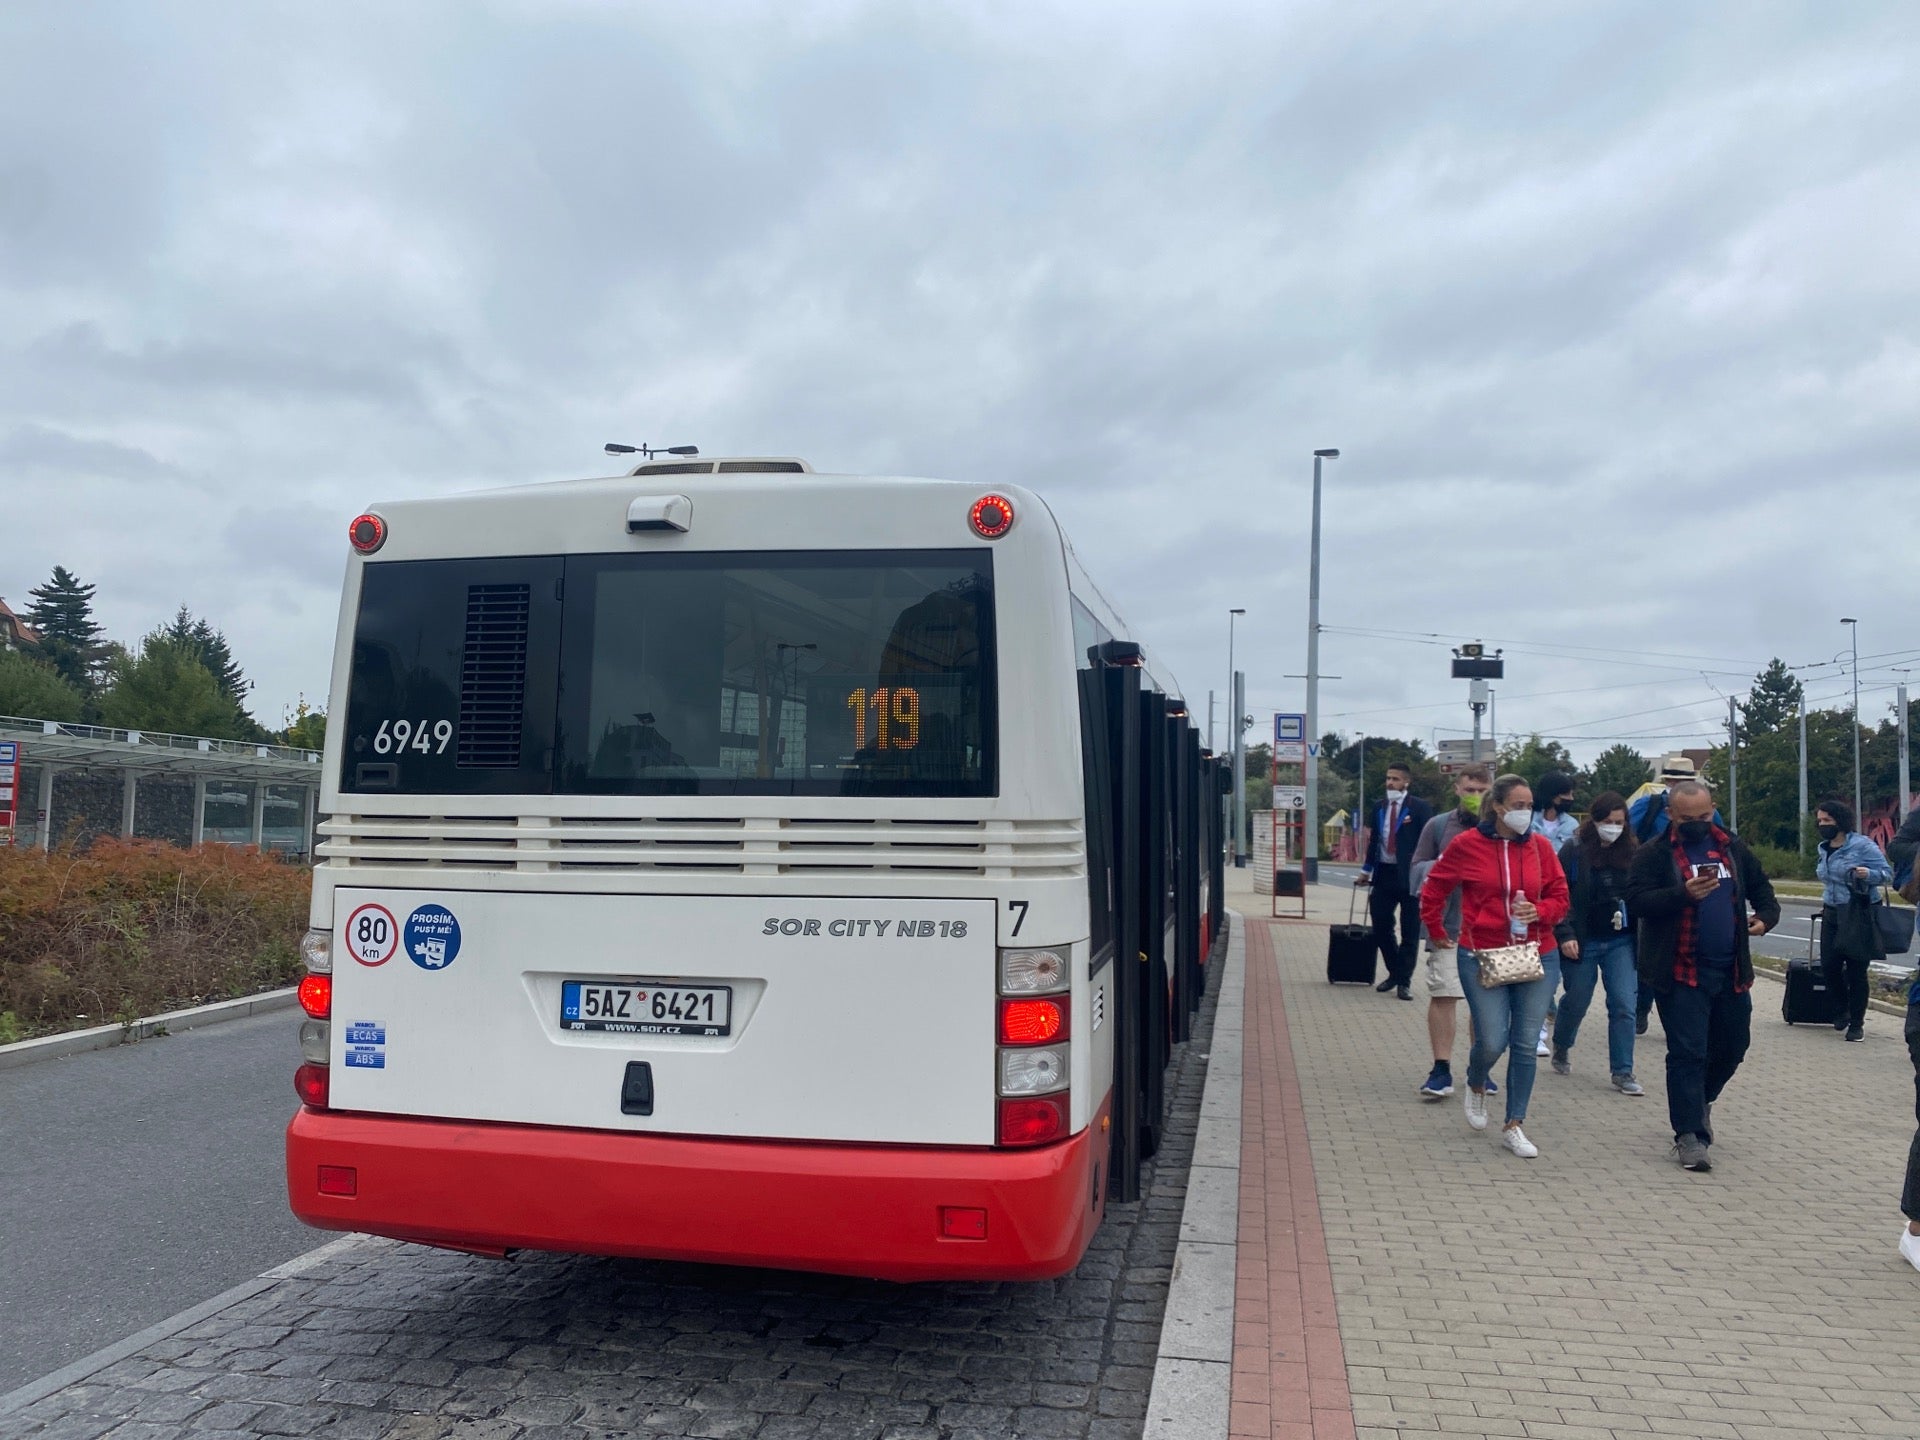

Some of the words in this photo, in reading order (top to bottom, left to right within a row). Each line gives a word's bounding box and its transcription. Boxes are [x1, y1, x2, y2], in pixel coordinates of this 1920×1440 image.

[847, 687, 919, 750] 119
[373, 719, 453, 754] 6949
[1308, 744, 1319, 756] V
[411, 913, 455, 926] PROSÍM,
[1009, 900, 1029, 937] 7
[358, 916, 388, 944] 80
[762, 917, 822, 936] SOR
[828, 919, 892, 937] CITY
[896, 920, 968, 938] NB18
[362, 946, 380, 958] km
[566, 1006, 578, 1016] CZ
[585, 988, 631, 1018] 5AZ
[652, 991, 714, 1021] 6421
[605, 1023, 681, 1034] www.sor.cz
[353, 1030, 378, 1041] ECAS
[355, 1054, 375, 1065] ABS
